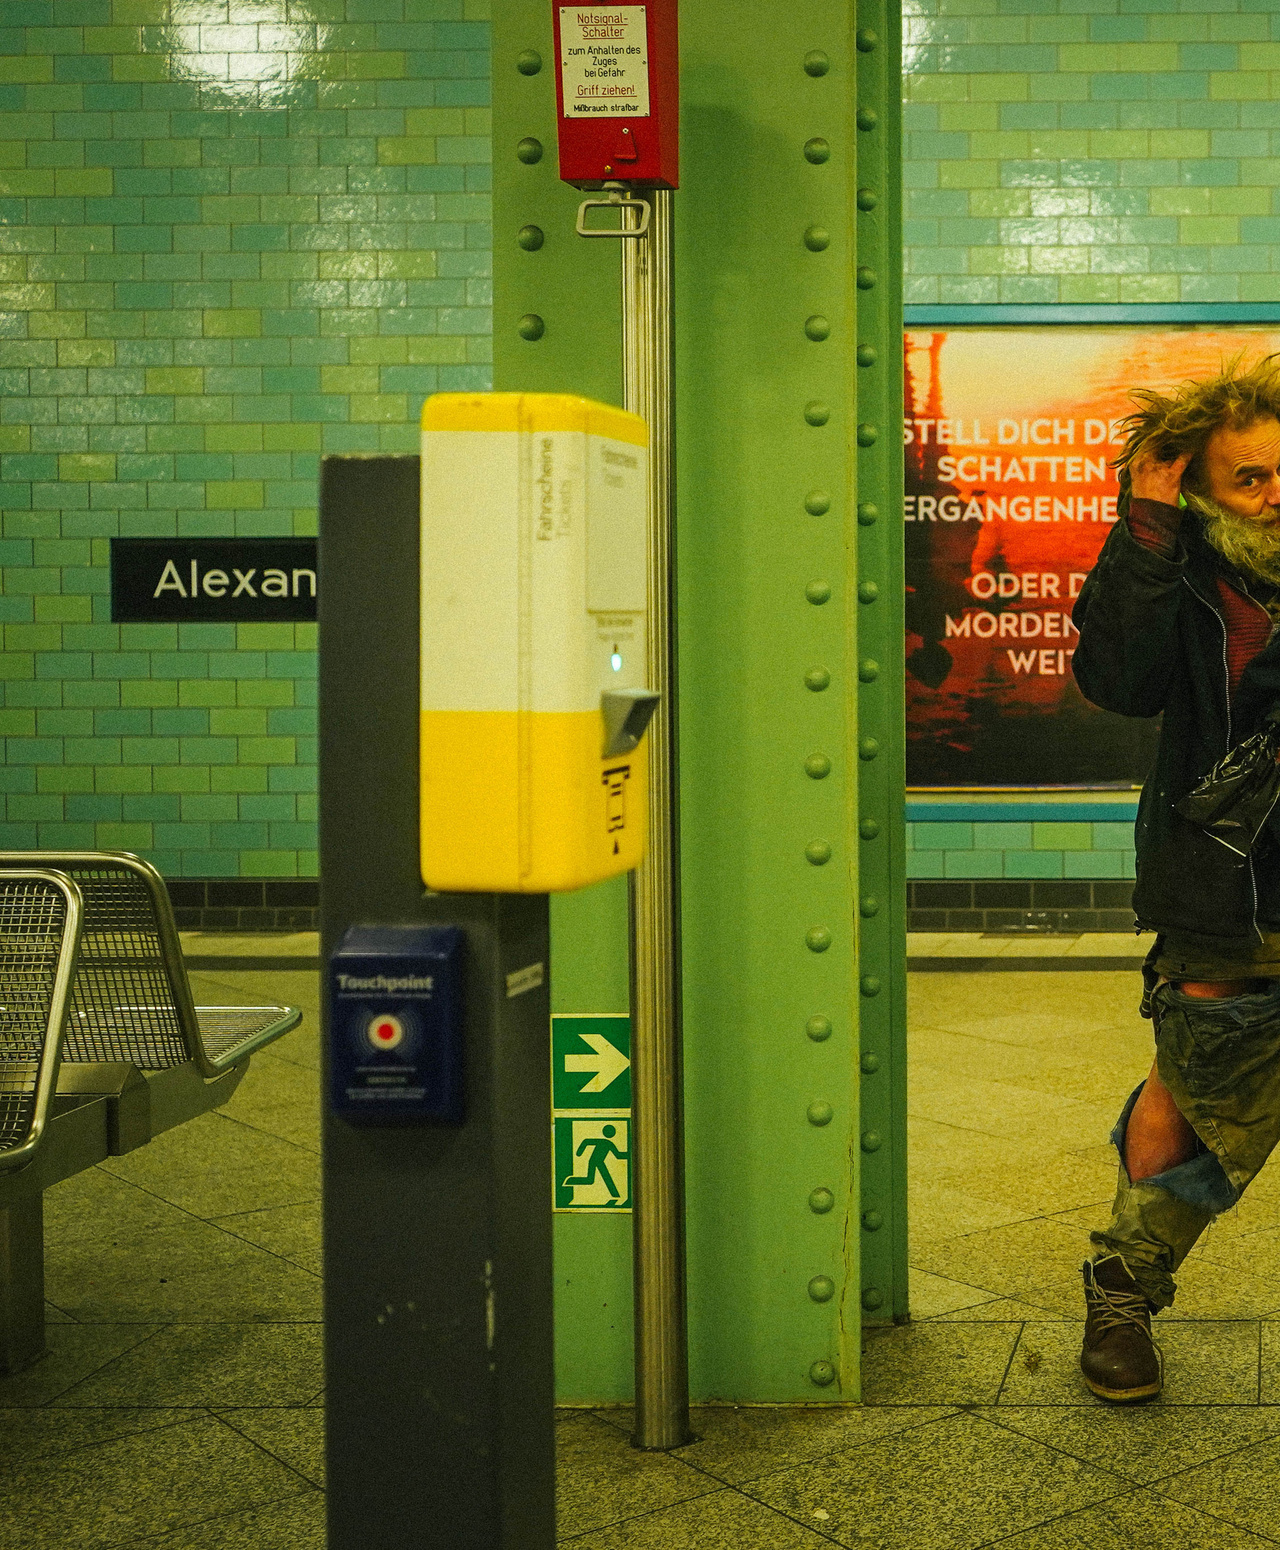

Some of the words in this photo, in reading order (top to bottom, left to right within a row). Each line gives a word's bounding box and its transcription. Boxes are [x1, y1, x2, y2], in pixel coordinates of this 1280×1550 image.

[577, 13, 628, 26] Notsignal-
[582, 26, 624, 37] Schalter
[587, 45, 624, 55] Anhalten
[626, 45, 641, 54] des
[592, 56, 617, 67] Zuges
[584, 68, 596, 77] bei
[598, 68, 625, 77] Gefahr
[577, 85, 599, 95] Griff
[602, 85, 635, 95] ziehen!
[574, 104, 608, 112] Mißbrauch
[611, 103, 639, 112] strafbar
[997, 418, 1075, 445] DICH
[937, 455, 1106, 482] SCHATTEN
[153, 559, 317, 598] Alexan
[971, 572, 1061, 598] ODER
[336, 974, 434, 992] Touchpoint
